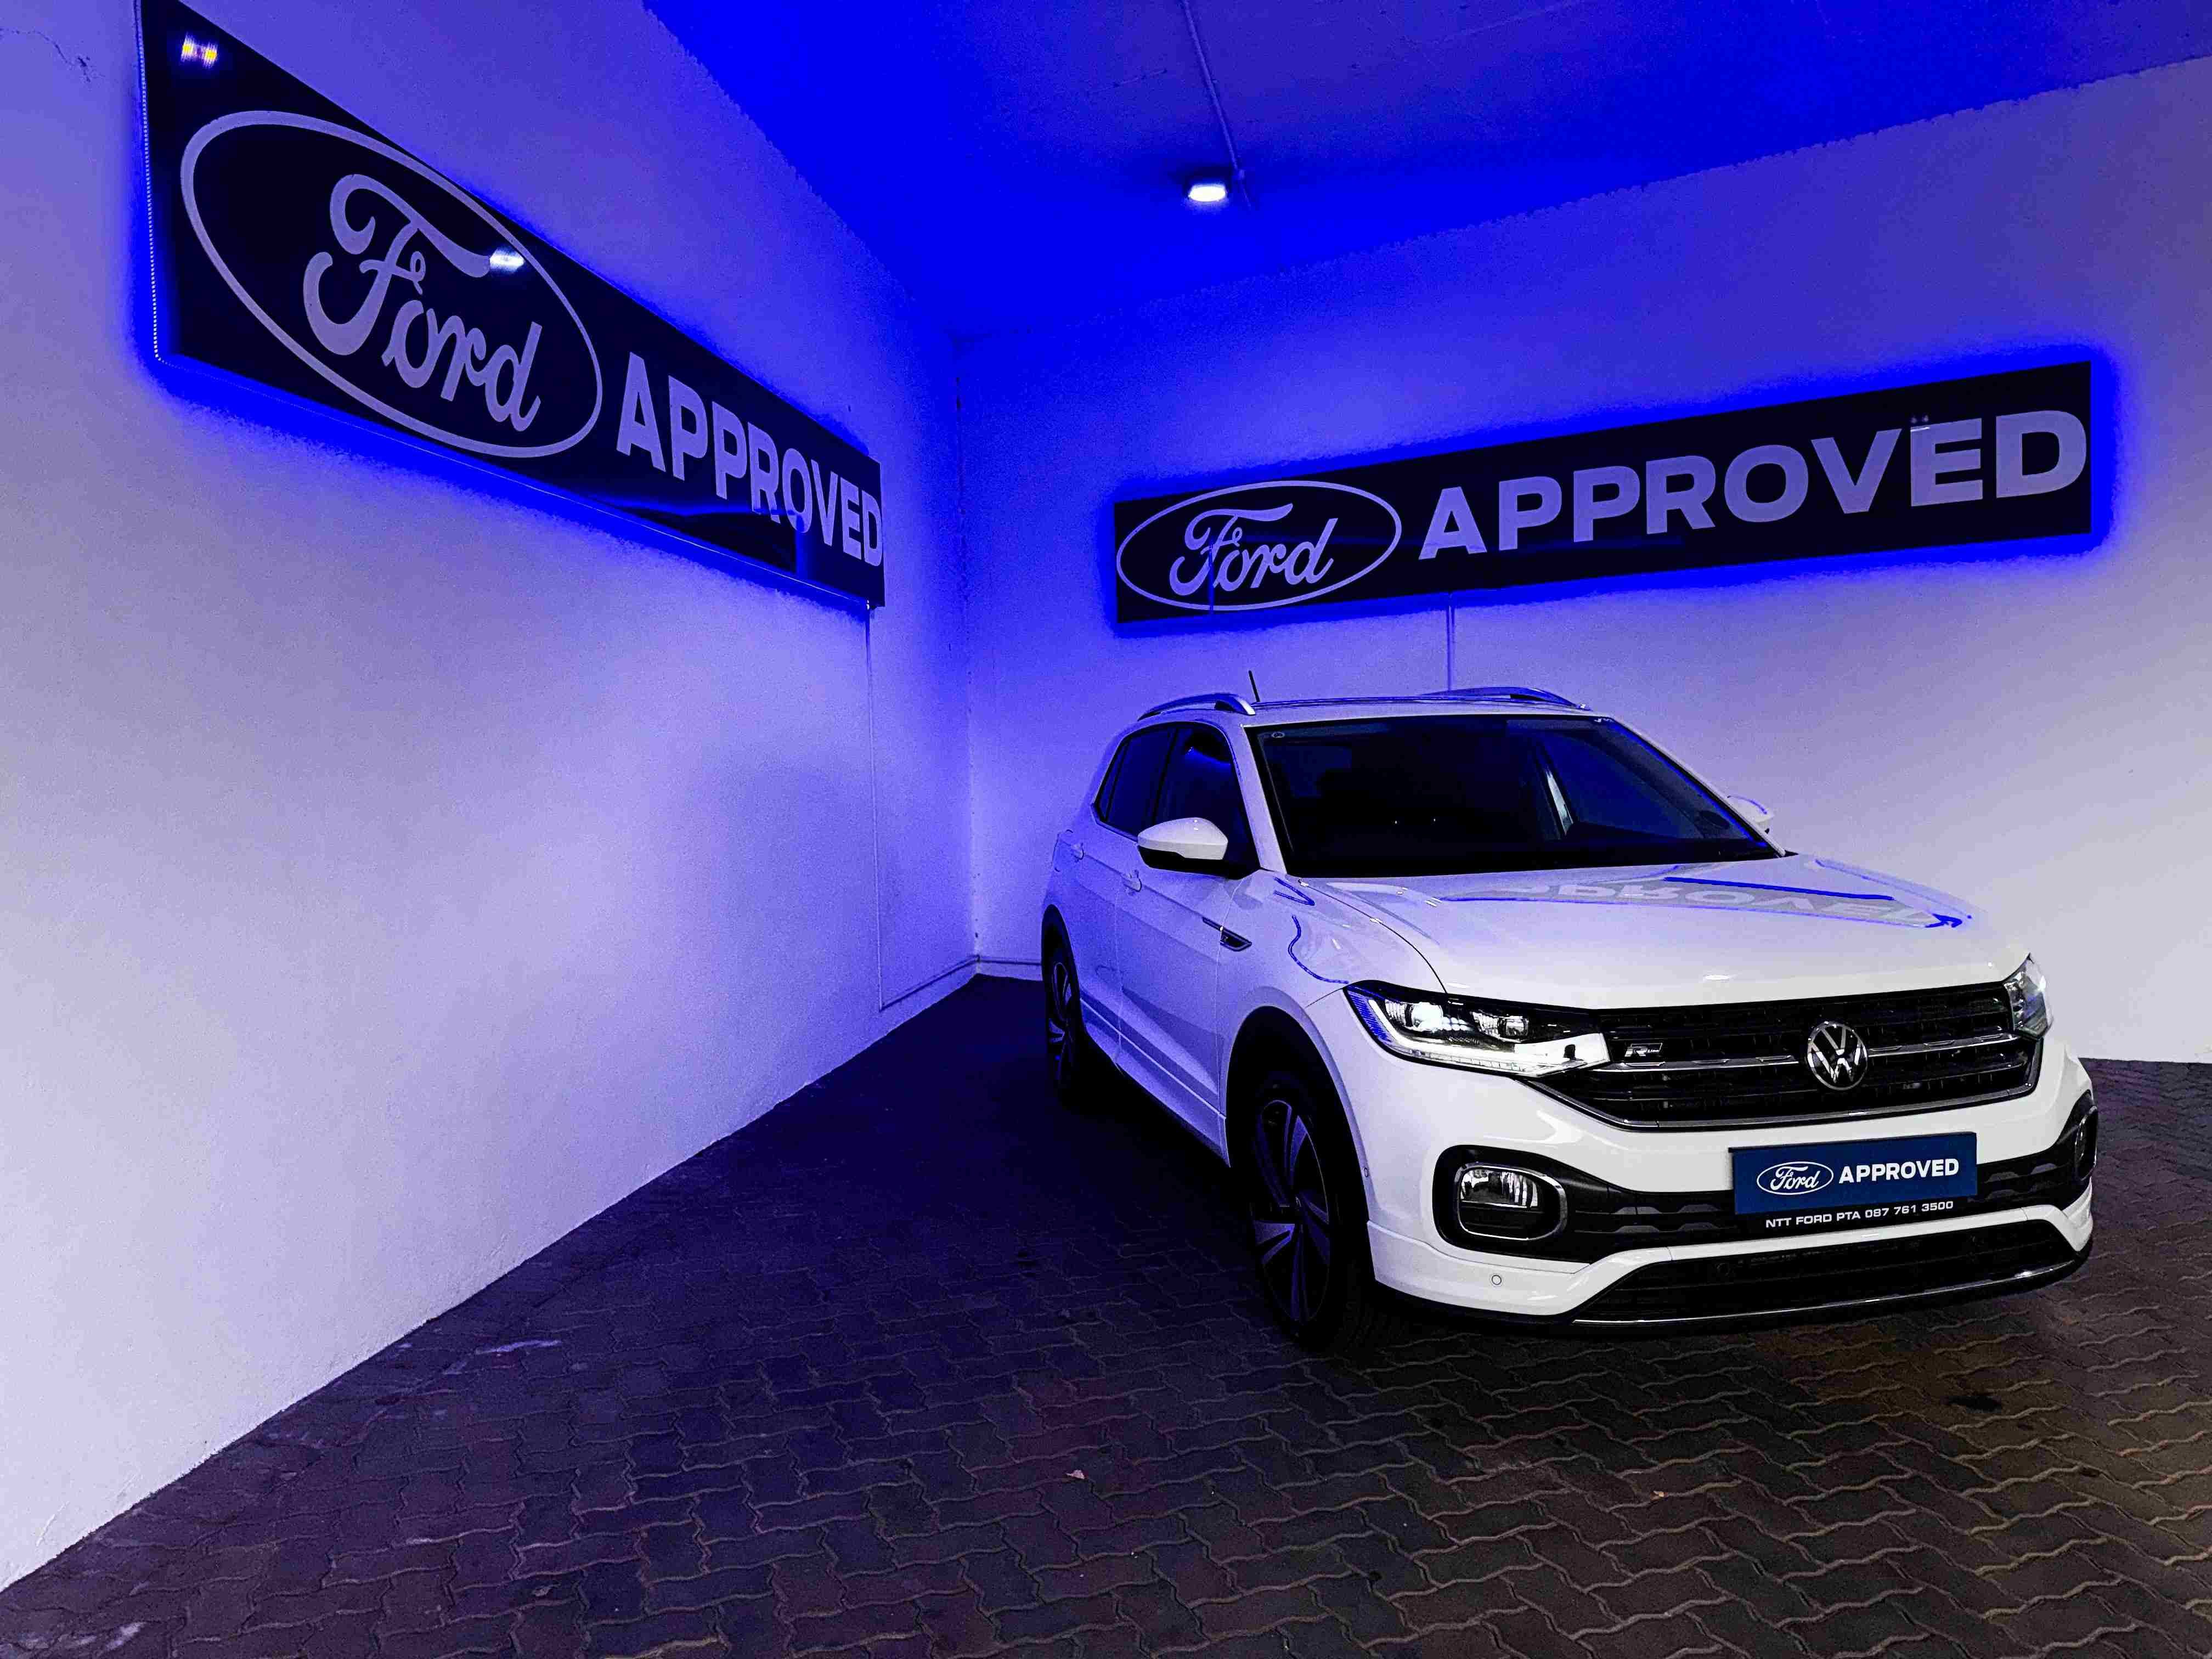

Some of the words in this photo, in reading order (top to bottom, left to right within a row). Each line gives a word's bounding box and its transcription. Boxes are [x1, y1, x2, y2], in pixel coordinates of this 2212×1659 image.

[303, 174, 542, 431] Ford
[616, 352, 883, 566] APPROVED
[1170, 503, 1338, 596] Ford
[1419, 410, 2086, 560] APPROVED
[1765, 1217, 1791, 1228] NTT
[1796, 1213, 1832, 1225] FORD
[1836, 1211, 1861, 1222] PTA
[1865, 1207, 1889, 1218] 087
[1894, 1204, 1917, 1215] 761
[1921, 1200, 1954, 1212] 3500
[1770, 1166, 1819, 1190] Ford
[1839, 1158, 1959, 1184] APPROVED
